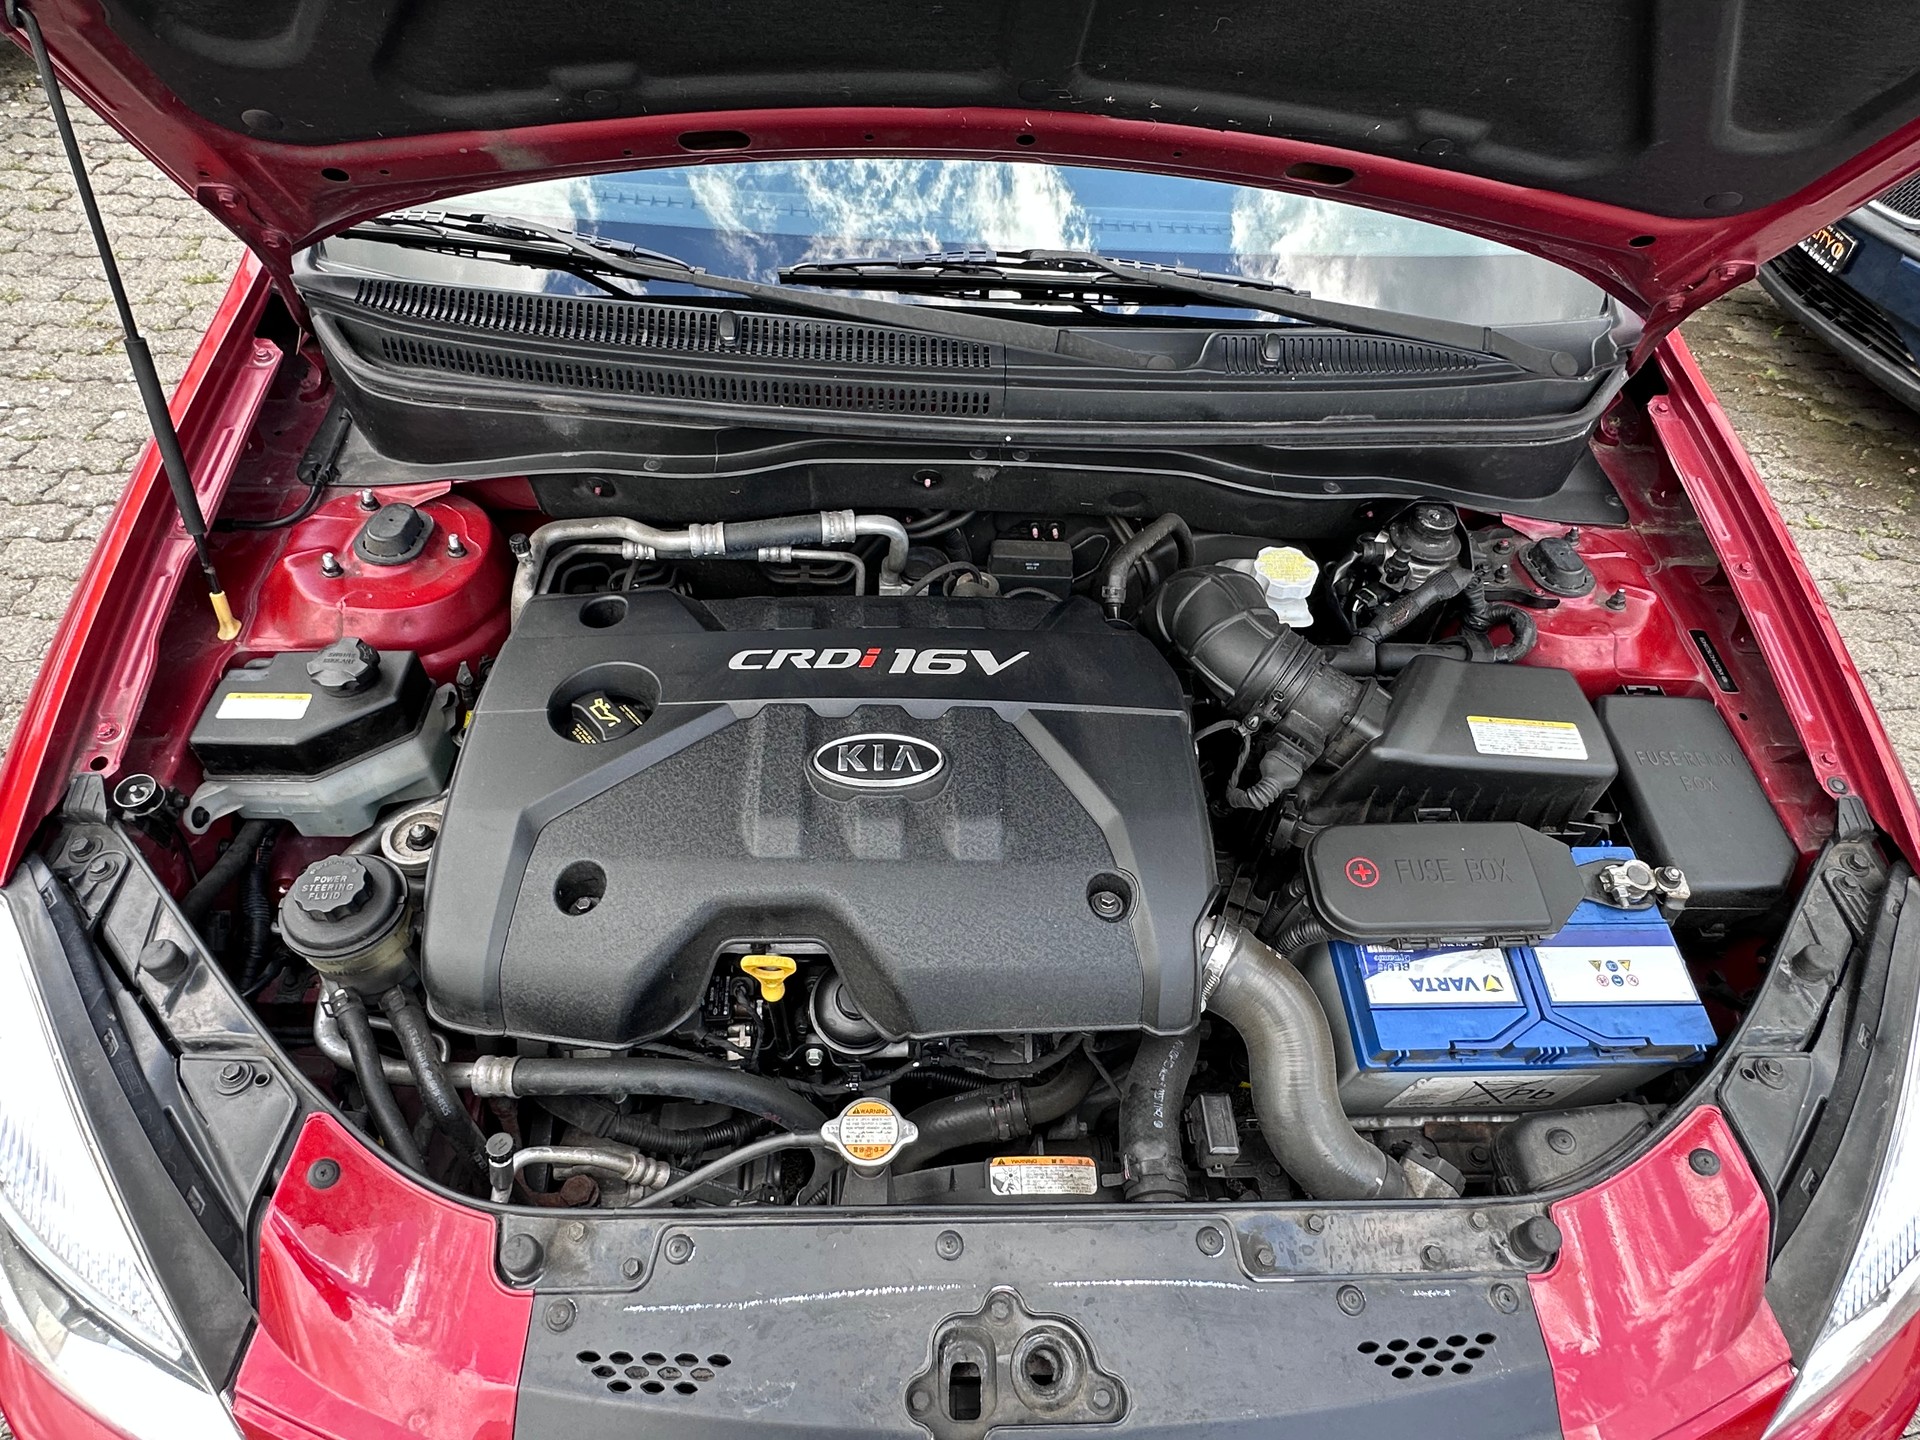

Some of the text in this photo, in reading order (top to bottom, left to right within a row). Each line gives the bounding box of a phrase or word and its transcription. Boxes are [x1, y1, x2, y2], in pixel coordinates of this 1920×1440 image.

[728, 648, 1030, 676] CRDi 16V
[837, 744, 923, 772] KIA
[1635, 751, 1682, 766] FUSE
[1680, 775, 1719, 792] BOX
[1394, 858, 1514, 882] FUSE BOX
[313, 875, 347, 883] POWER
[302, 883, 354, 892] STEERING
[308, 892, 341, 900] FLUID
[1378, 962, 1410, 972] BLUE
[1408, 977, 1480, 992] VARTA
[1504, 1088, 1555, 1100] Pb
